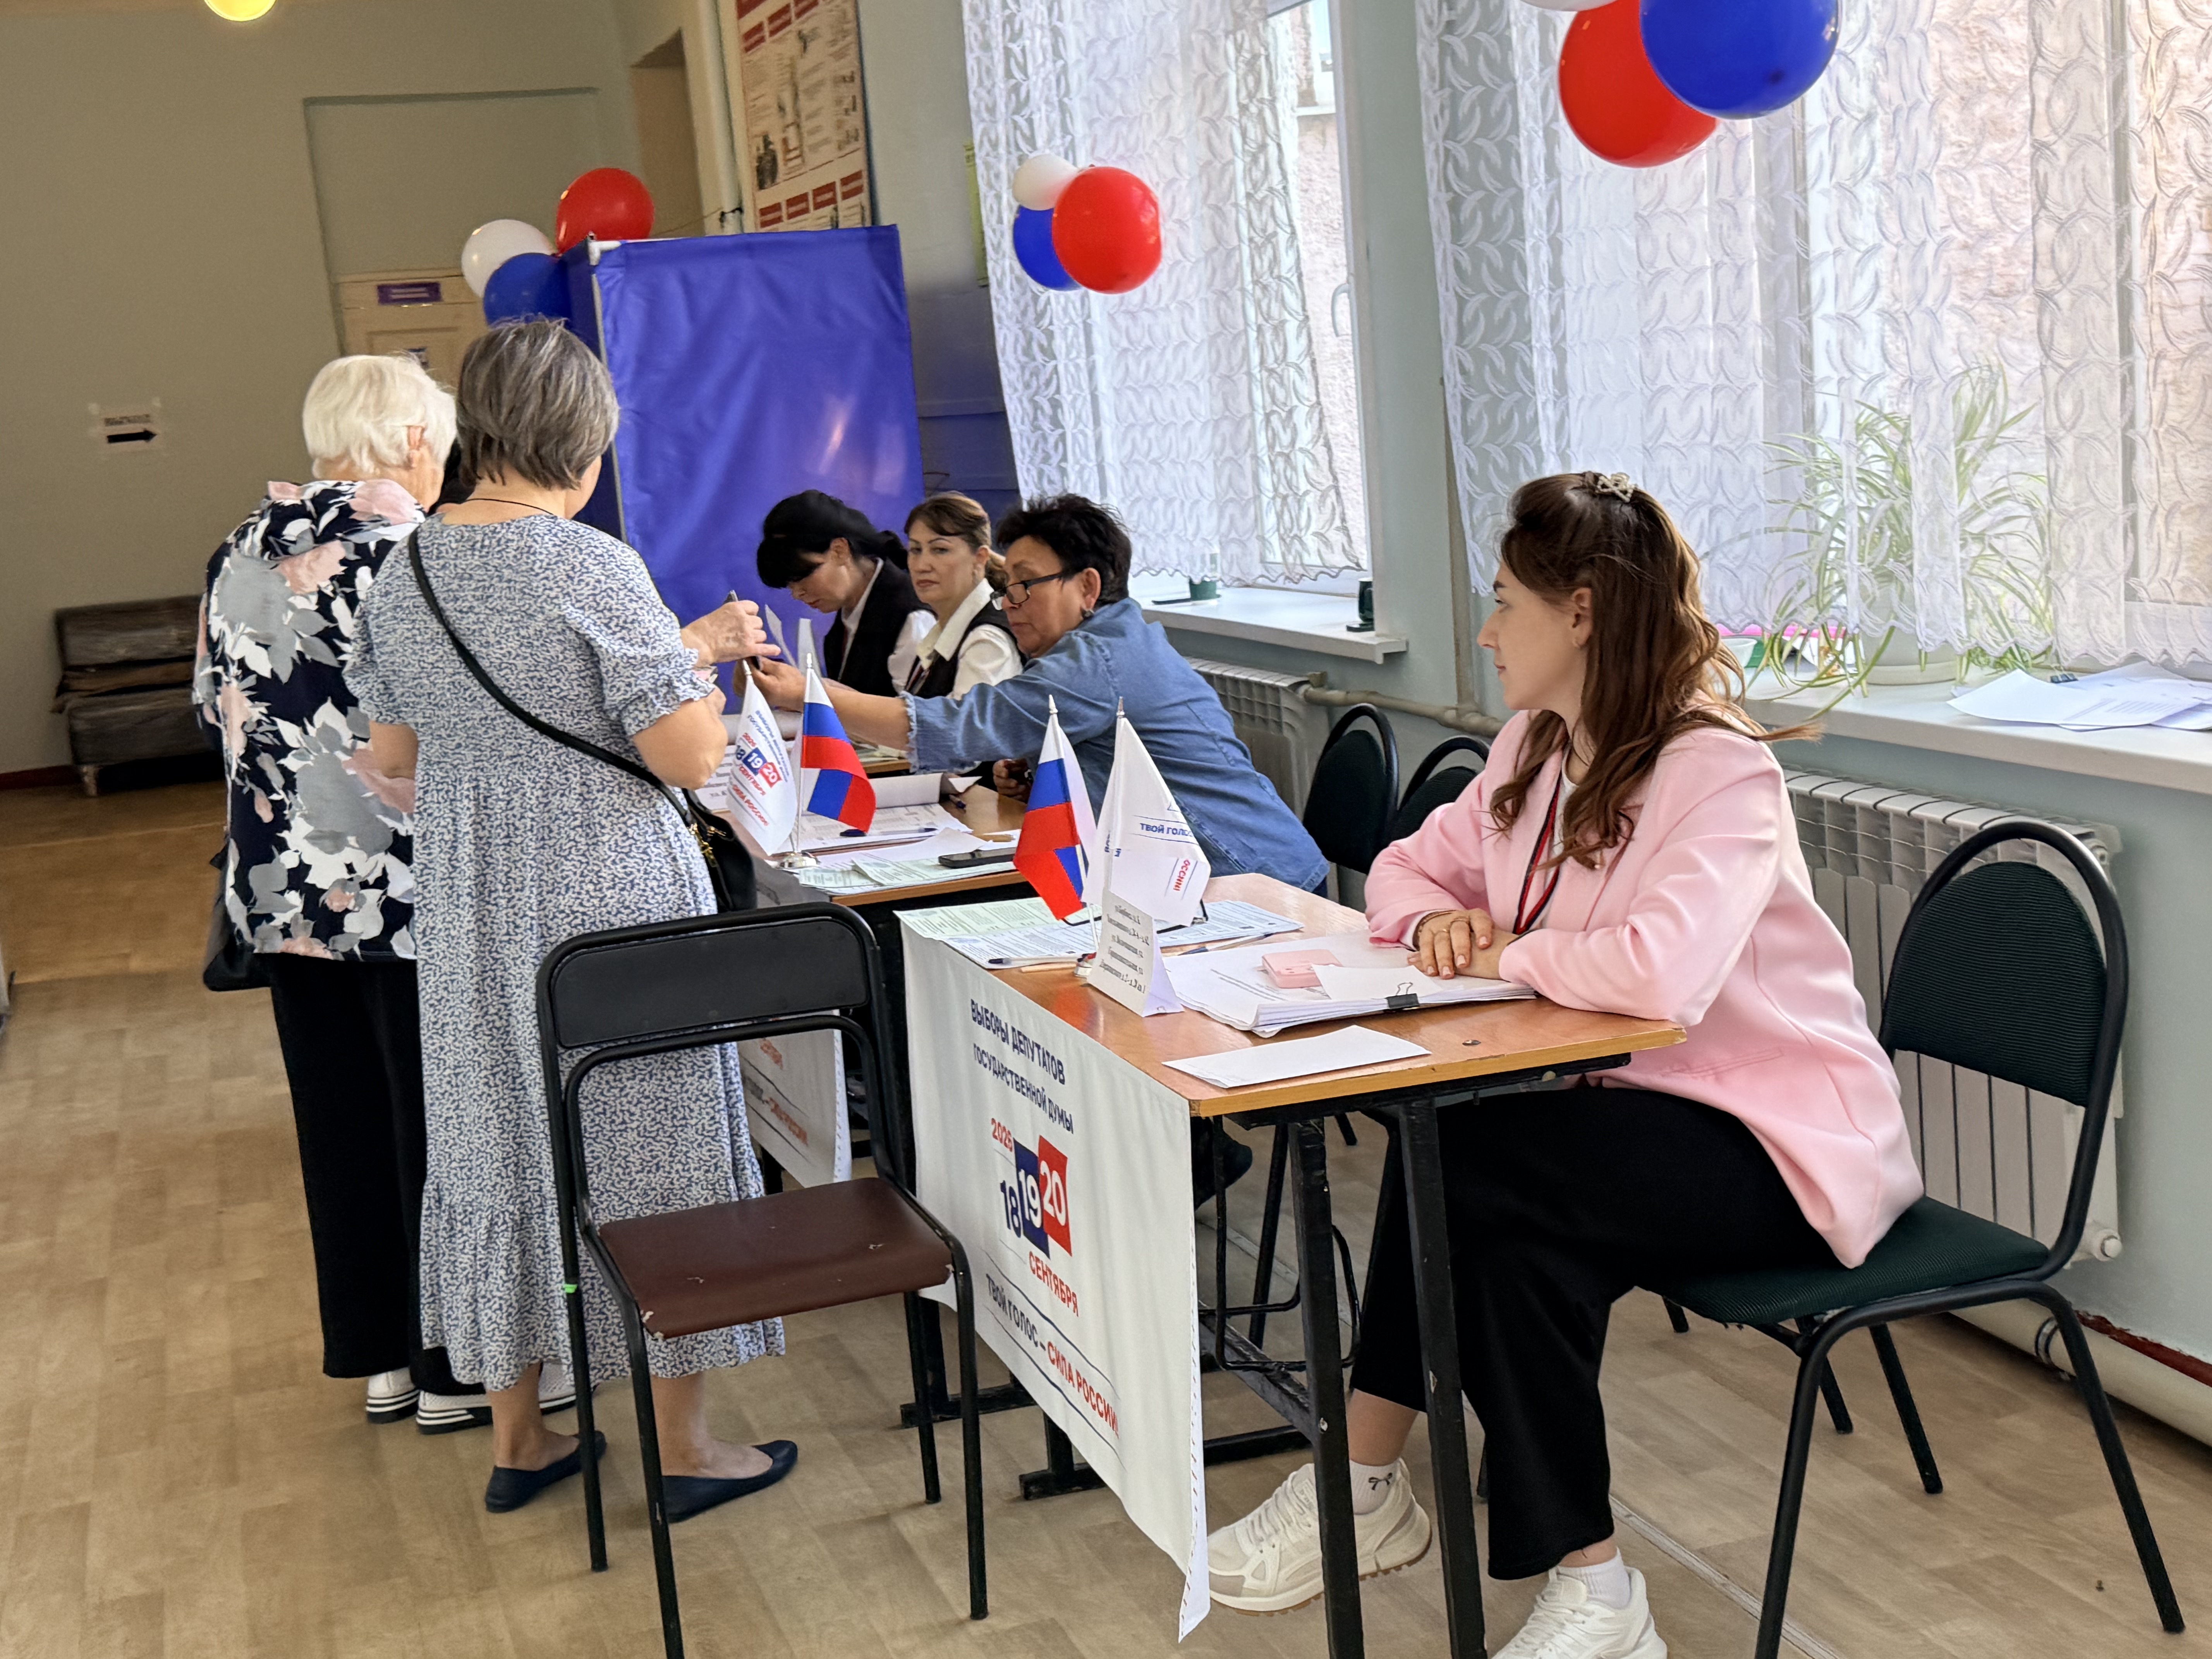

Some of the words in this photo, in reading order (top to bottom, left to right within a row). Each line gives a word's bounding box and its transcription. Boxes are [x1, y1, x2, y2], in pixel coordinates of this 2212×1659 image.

[748, 752, 763, 768] 19
[763, 764, 778, 783] 20
[1140, 823, 1164, 833] ТВОЙ
[1173, 859, 1191, 891] ОССИИ!
[971, 999, 1009, 1045] ВЫБОРЫ
[1012, 1025, 1065, 1085] ДЕПУТАТОВ
[973, 1043, 1047, 1114] ГОСУДАРСТВЕННОЙ
[1048, 1097, 1074, 1134] ДУМЫ
[1000, 1180, 1021, 1238] 18
[1018, 1169, 1042, 1228] 19
[1040, 1161, 1066, 1226] 20
[1029, 1251, 1079, 1317] СЕНТЯБРЯ
[986, 1273, 1007, 1315] ТВОЙ
[1007, 1299, 1038, 1348] ГОЛОС
[1048, 1341, 1075, 1388] СИЛА
